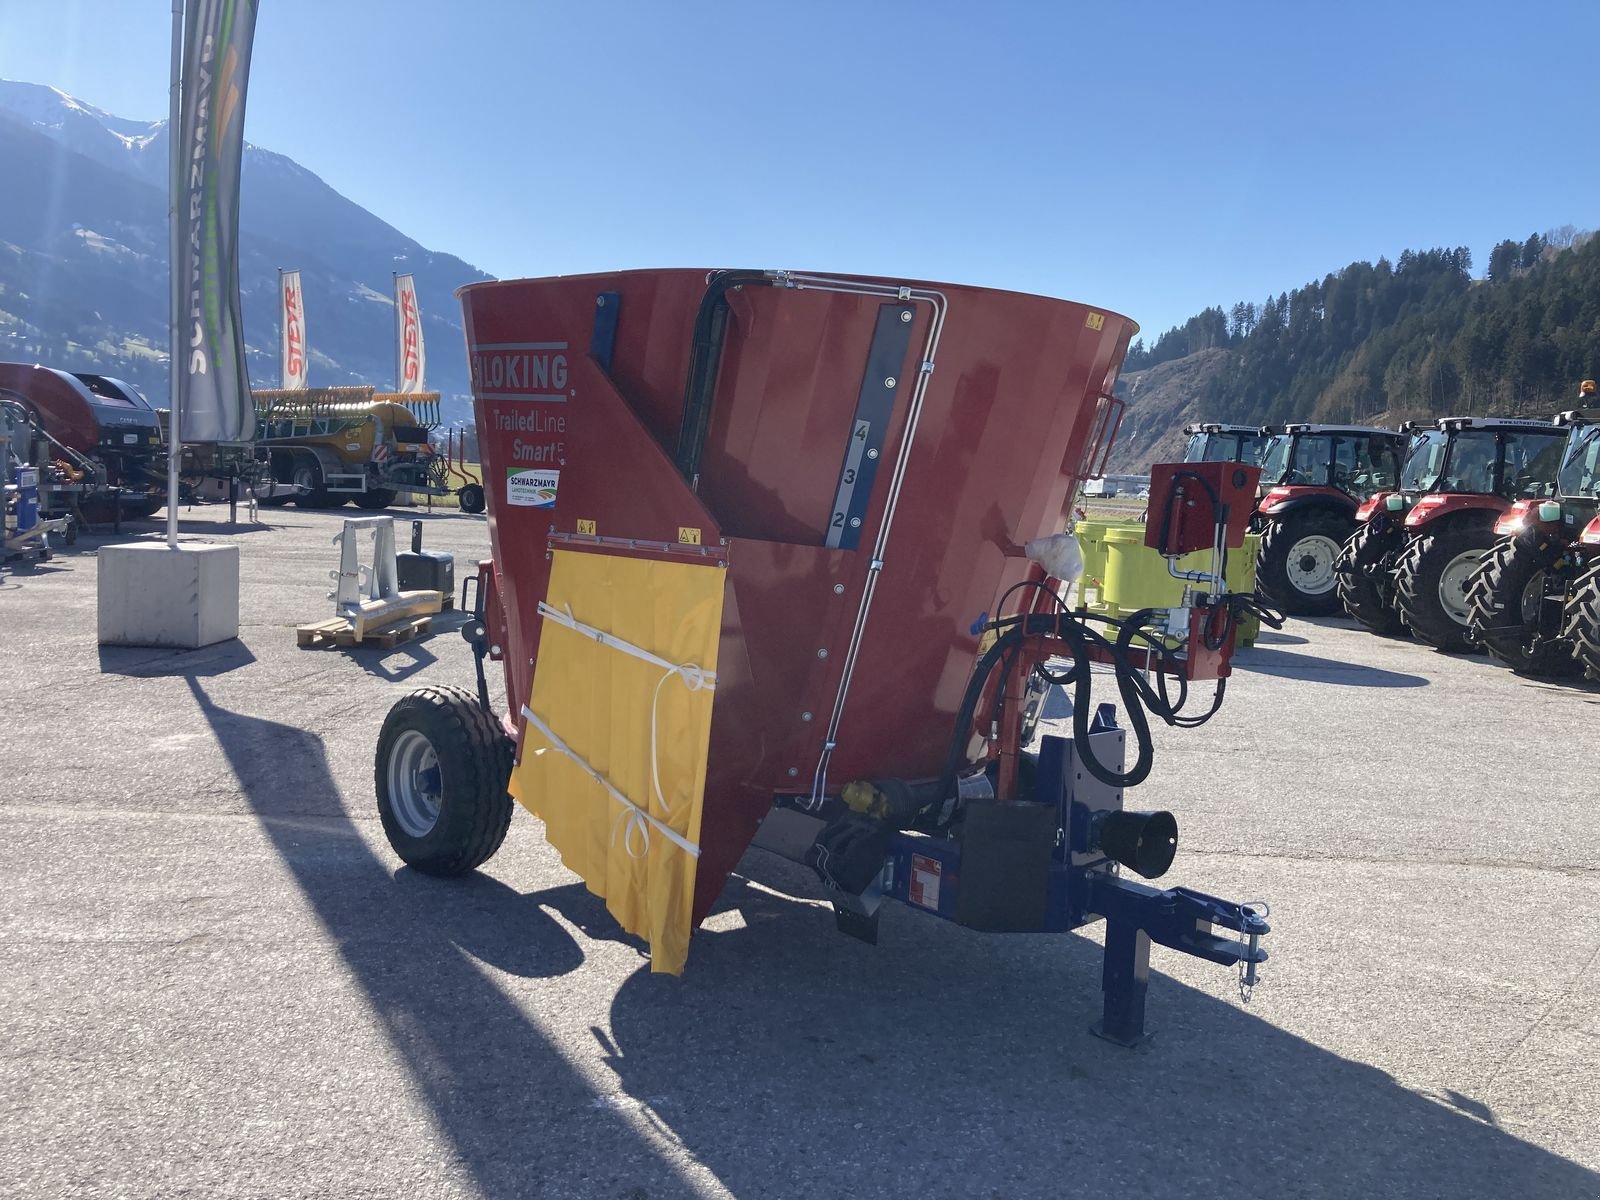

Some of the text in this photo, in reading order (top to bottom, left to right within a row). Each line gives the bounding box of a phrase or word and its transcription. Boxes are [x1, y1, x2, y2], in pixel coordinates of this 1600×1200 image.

[285, 286, 303, 380] STEYR
[402, 289, 418, 383] STEYR
[472, 354, 568, 389] SILOKING
[493, 409, 566, 433] TrailedLine
[855, 425, 866, 441] 4
[513, 438, 556, 463] Smart
[510, 476, 556, 489] SCHWARZMAYR
[844, 468, 856, 484] 3
[832, 512, 845, 528] 2
